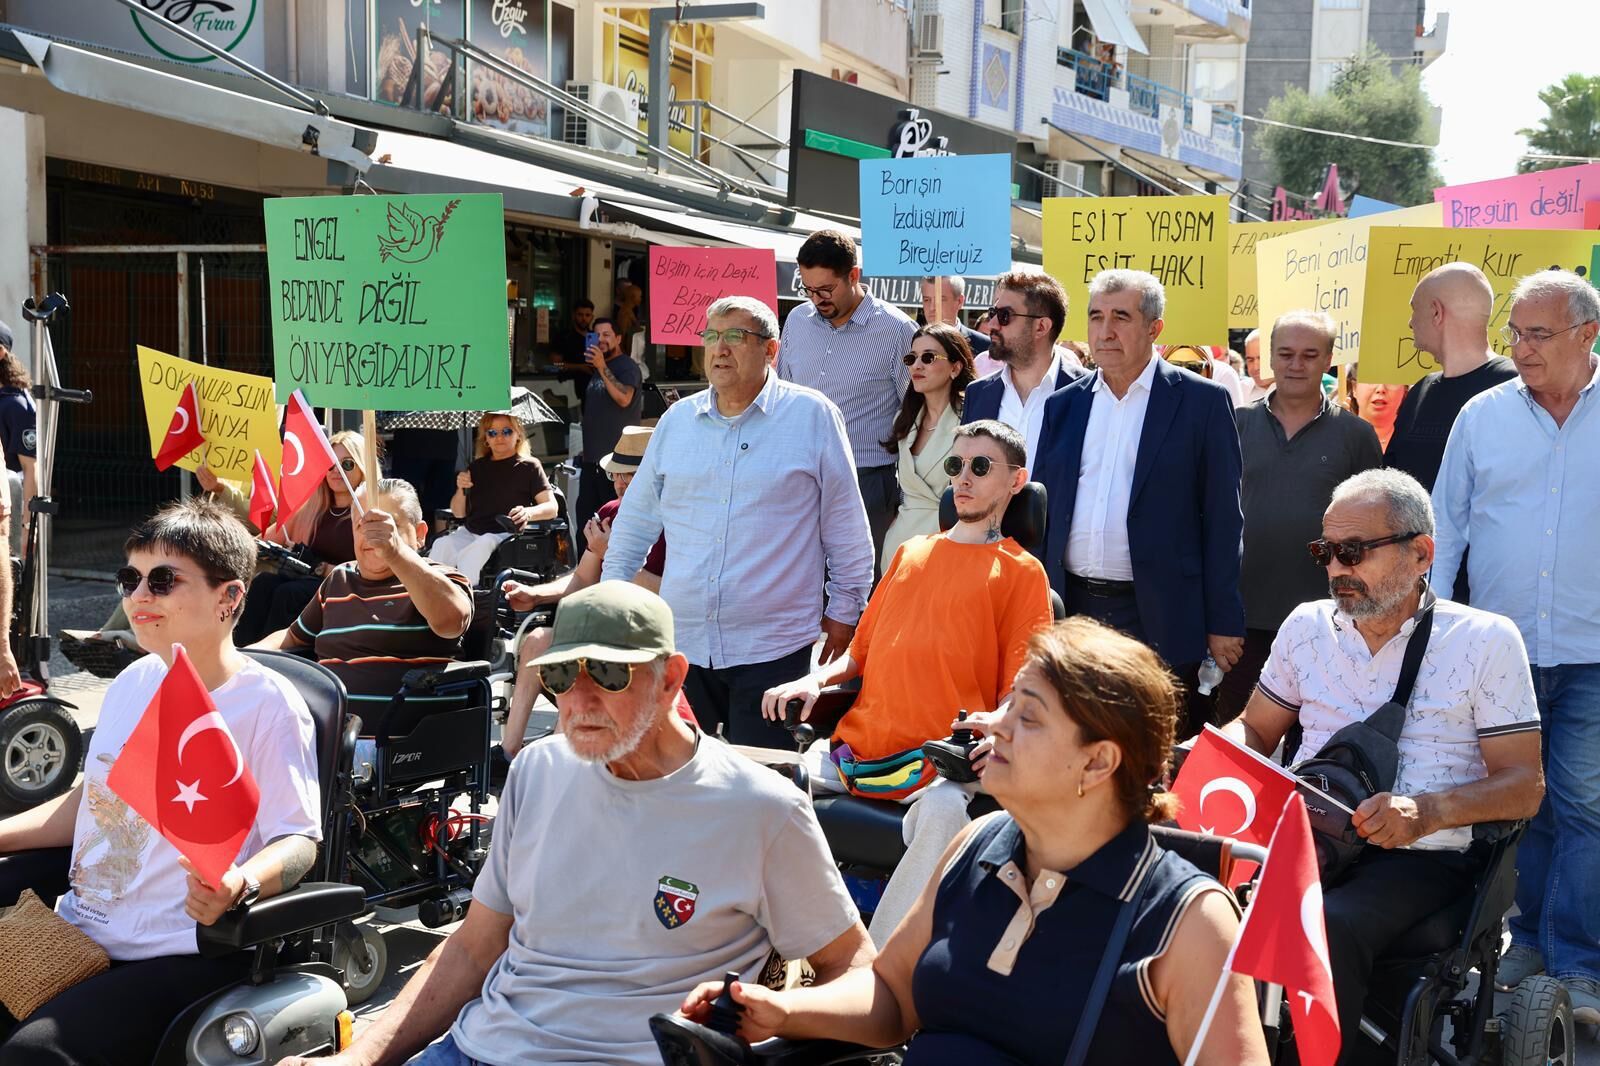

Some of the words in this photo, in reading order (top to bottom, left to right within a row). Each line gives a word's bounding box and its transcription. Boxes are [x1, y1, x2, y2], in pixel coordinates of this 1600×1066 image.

[881, 170, 942, 198] Barışın
[893, 203, 965, 232] İzdüşümü
[1145, 210, 1214, 243] YAŞAM
[294, 217, 345, 261] ENGEL
[899, 239, 983, 274] Bireyleriyiz
[1150, 254, 1205, 290] HAK!
[1481, 244, 1523, 277] kur
[281, 280, 345, 324] BEDENDE
[358, 272, 428, 325] DEĞİL
[200, 409, 249, 441] ÜNYA
